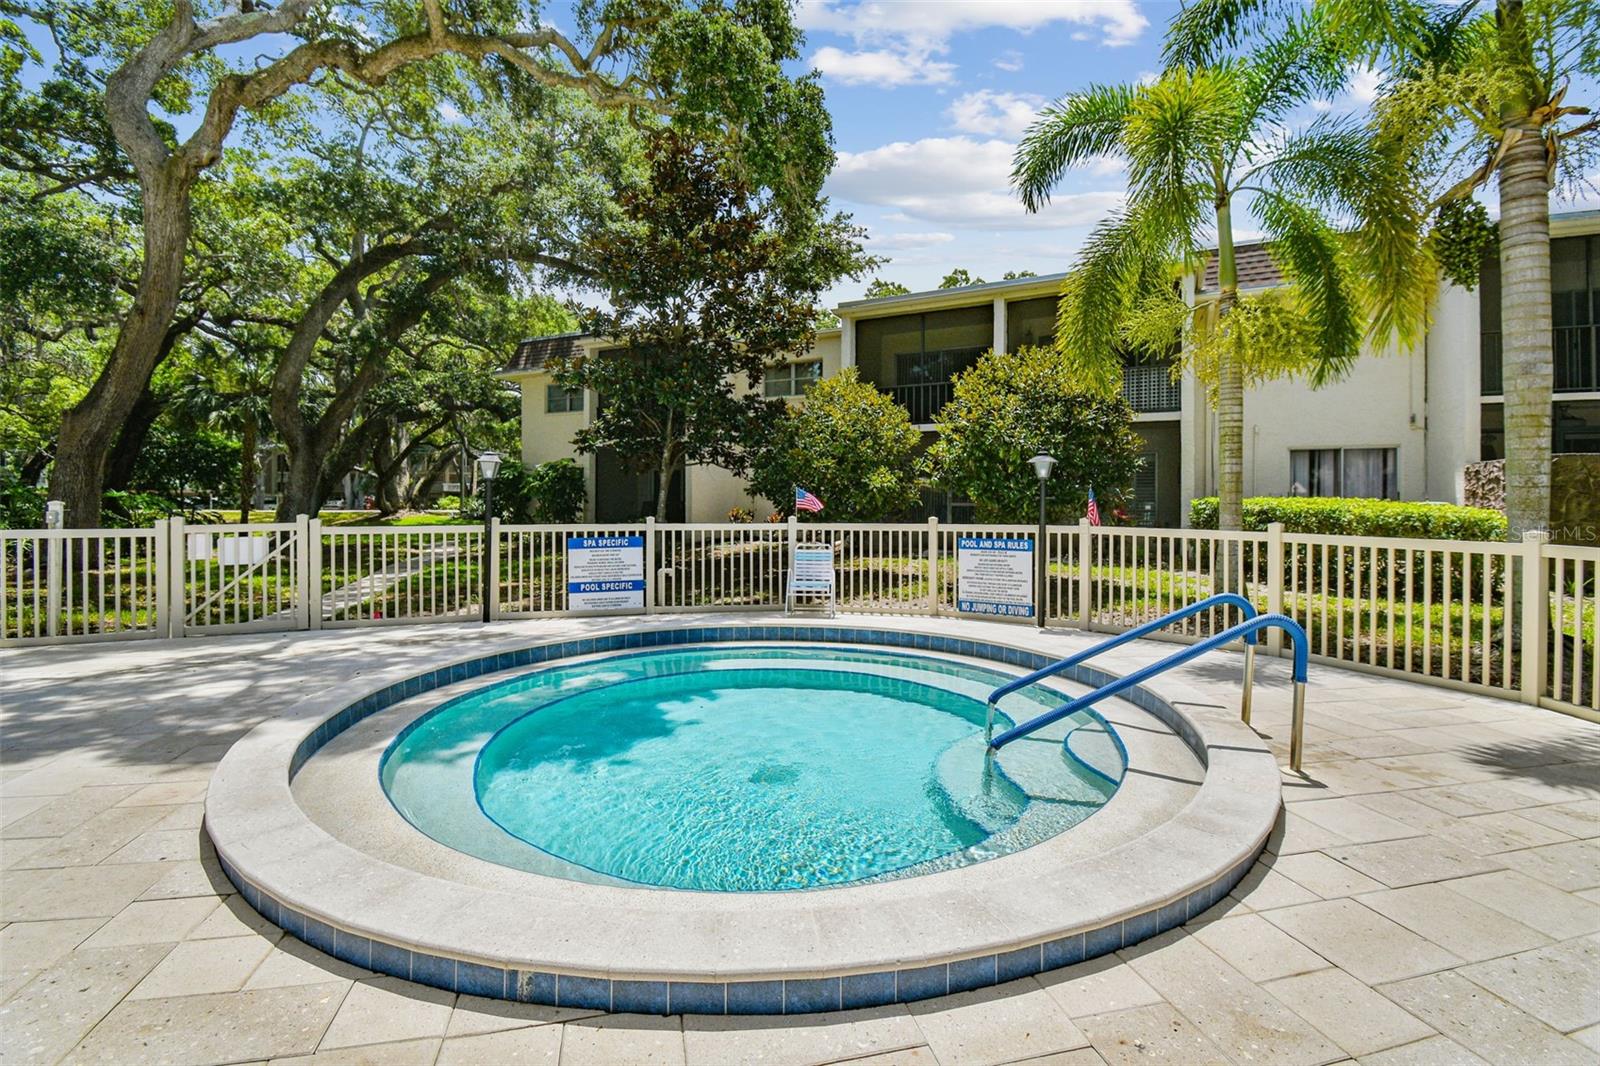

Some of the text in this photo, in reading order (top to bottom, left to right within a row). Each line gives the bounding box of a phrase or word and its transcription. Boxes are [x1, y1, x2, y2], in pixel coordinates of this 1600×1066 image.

[583, 539, 597, 547] SPA
[961, 540, 1029, 550] POOL AND SPA RULES
[961, 602, 971, 611] NO
[971, 602, 997, 613] JUMPING
[997, 604, 1007, 614] OR
[1007, 605, 1030, 616] DIVING
